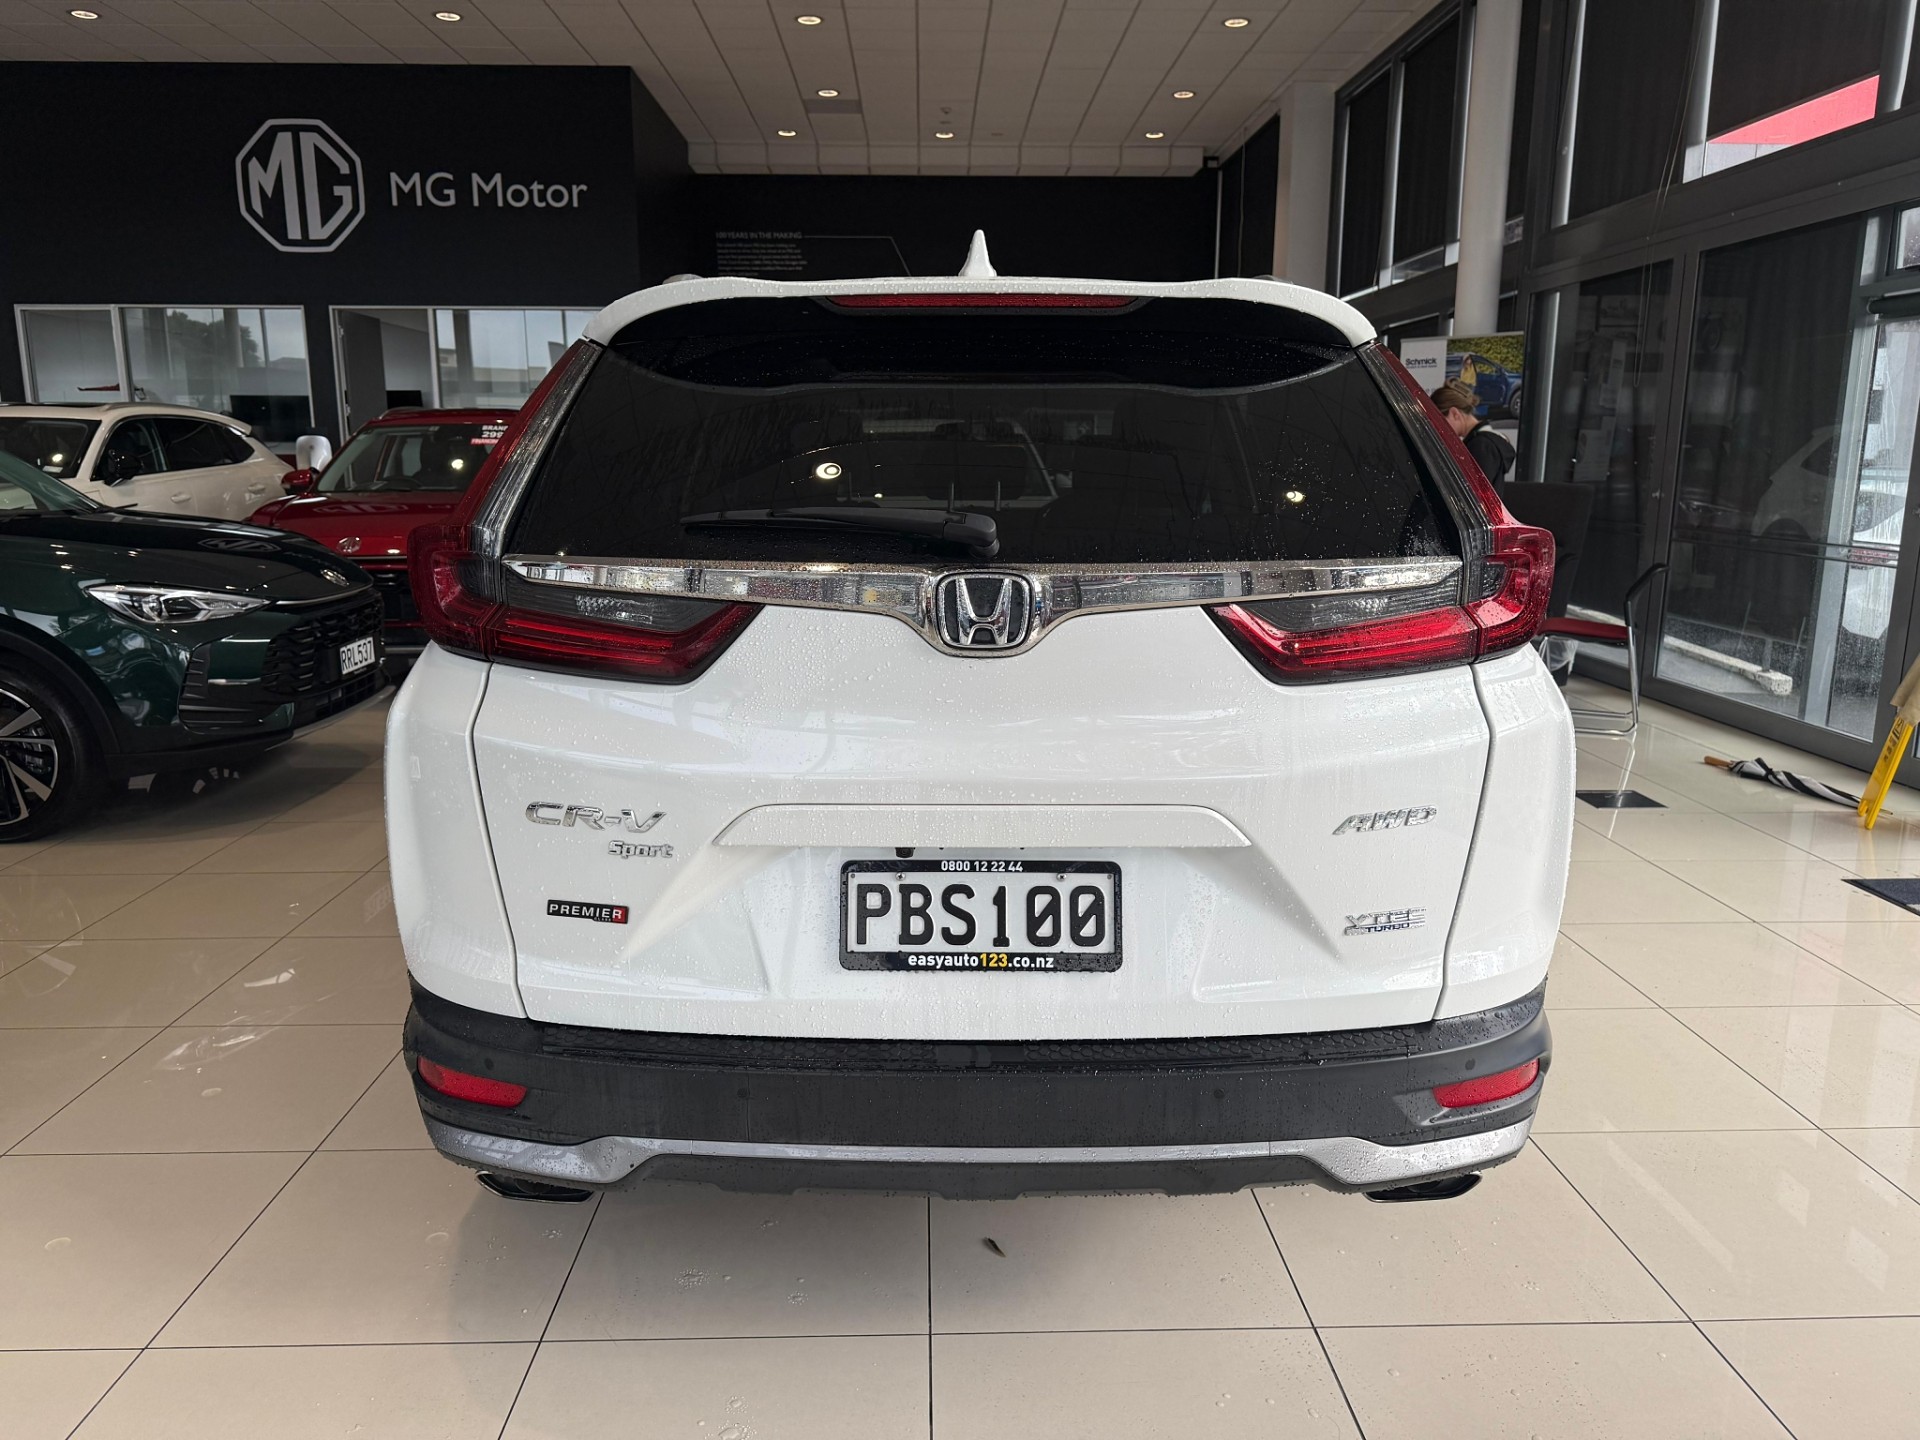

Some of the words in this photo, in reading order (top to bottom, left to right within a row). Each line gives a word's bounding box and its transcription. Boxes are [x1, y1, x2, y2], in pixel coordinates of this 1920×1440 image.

[247, 131, 354, 241] MG
[389, 171, 457, 208] MG
[470, 172, 588, 208] Motor
[727, 231, 748, 239] YEARS
[758, 231, 772, 239] THE
[773, 231, 802, 239] MAKING
[1406, 357, 1437, 365] Schmick
[340, 641, 373, 671] RRL537
[525, 801, 667, 833] CR-V
[1332, 805, 1437, 835] AWD
[608, 840, 674, 859] Sport
[941, 861, 970, 871] 0800
[974, 861, 988, 872] 12
[990, 861, 1006, 872] 22
[1008, 861, 1023, 872] 44
[549, 903, 622, 919] PREMIER
[856, 884, 1106, 947] PBS100
[1366, 922, 1410, 933] TURBO
[908, 953, 1054, 968] easyauto123.co.nz
